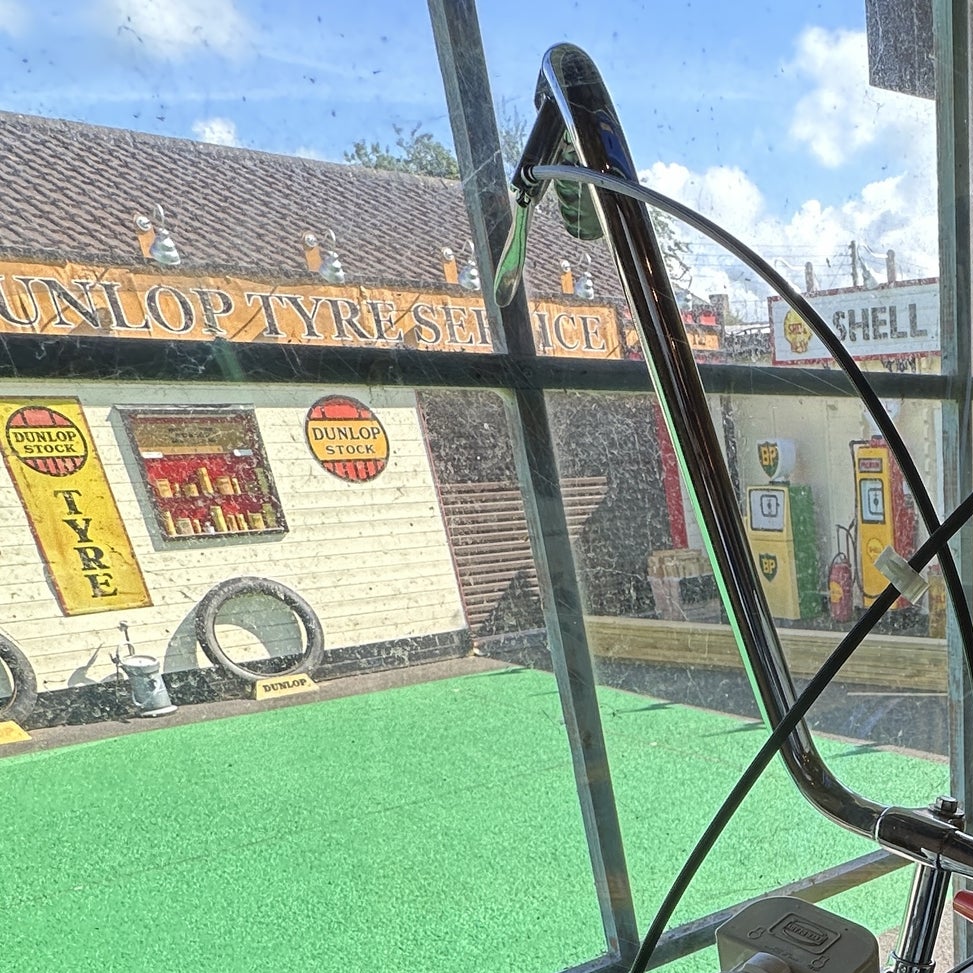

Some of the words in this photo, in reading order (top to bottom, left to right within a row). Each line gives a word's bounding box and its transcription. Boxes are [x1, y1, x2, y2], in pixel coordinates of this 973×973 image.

[0, 276, 234, 335] UNLOP
[245, 292, 404, 342] TYRE
[413, 302, 607, 351] SEICE
[832, 303, 928, 342] SHELL
[13, 430, 77, 443] DUNLOP
[312, 427, 381, 441] DUNLOP
[24, 443, 76, 454] STOCK
[326, 444, 376, 455] STOCK
[760, 449, 777, 467] BP
[54, 489, 118, 598] TYRE
[761, 560, 776, 574] BP
[262, 678, 307, 693] DUNLOP
